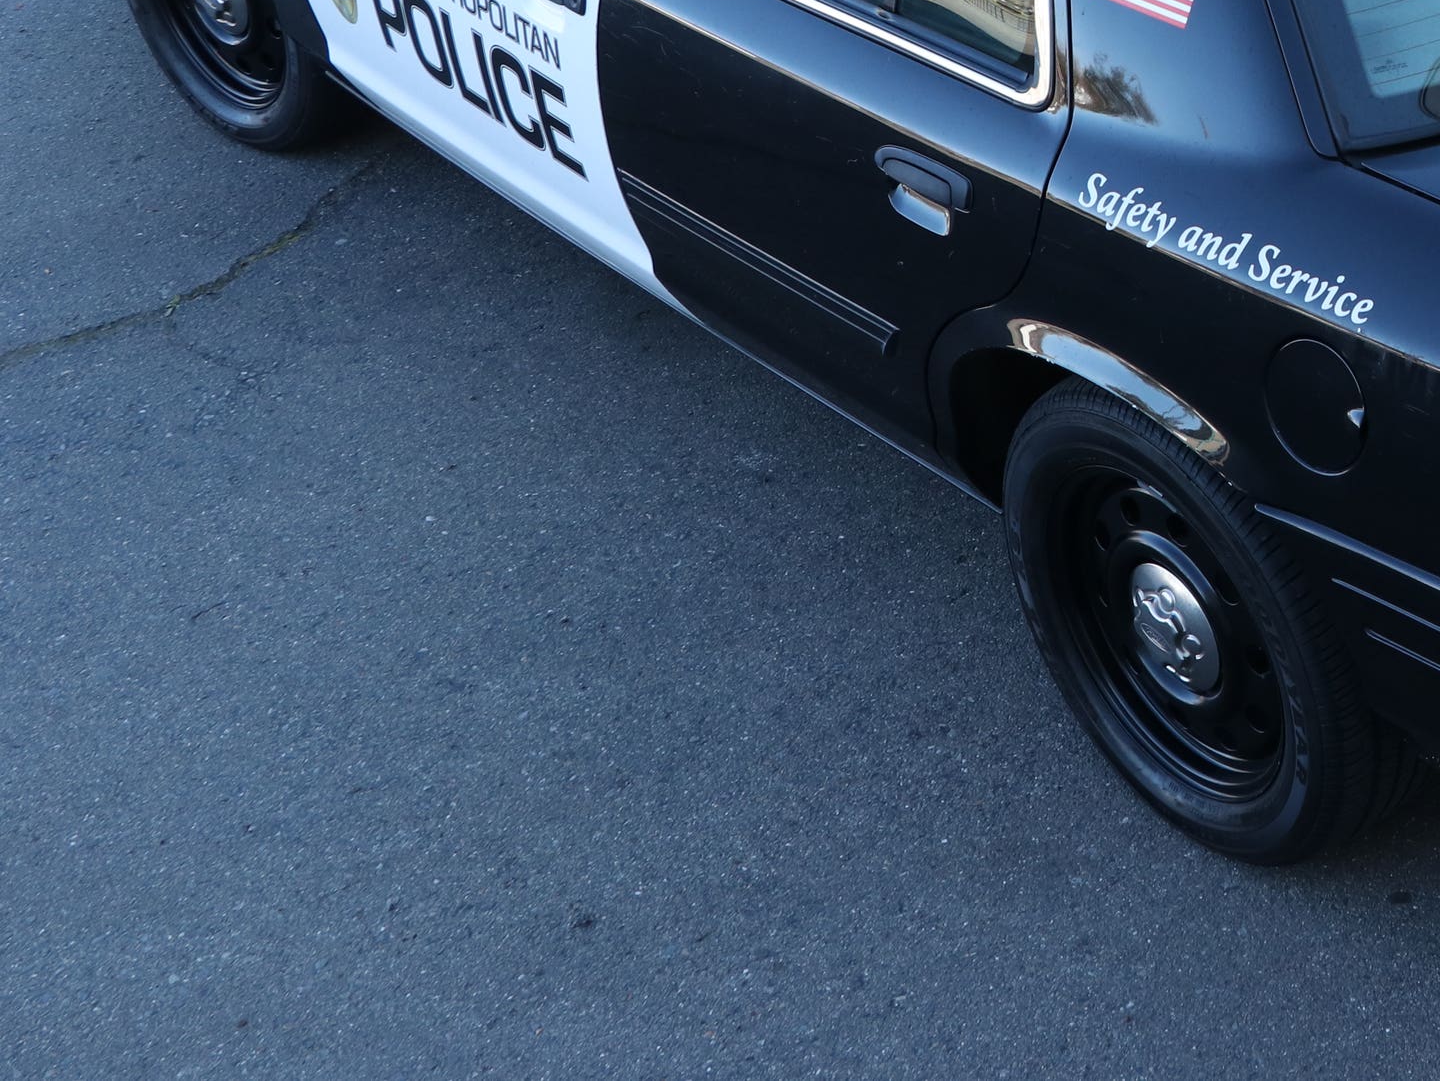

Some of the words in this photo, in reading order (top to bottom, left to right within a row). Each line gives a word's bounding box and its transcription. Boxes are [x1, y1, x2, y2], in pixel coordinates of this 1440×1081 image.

[1078, 173, 1177, 249] Safety
[1178, 225, 1253, 270] and
[1248, 244, 1375, 324] Service
